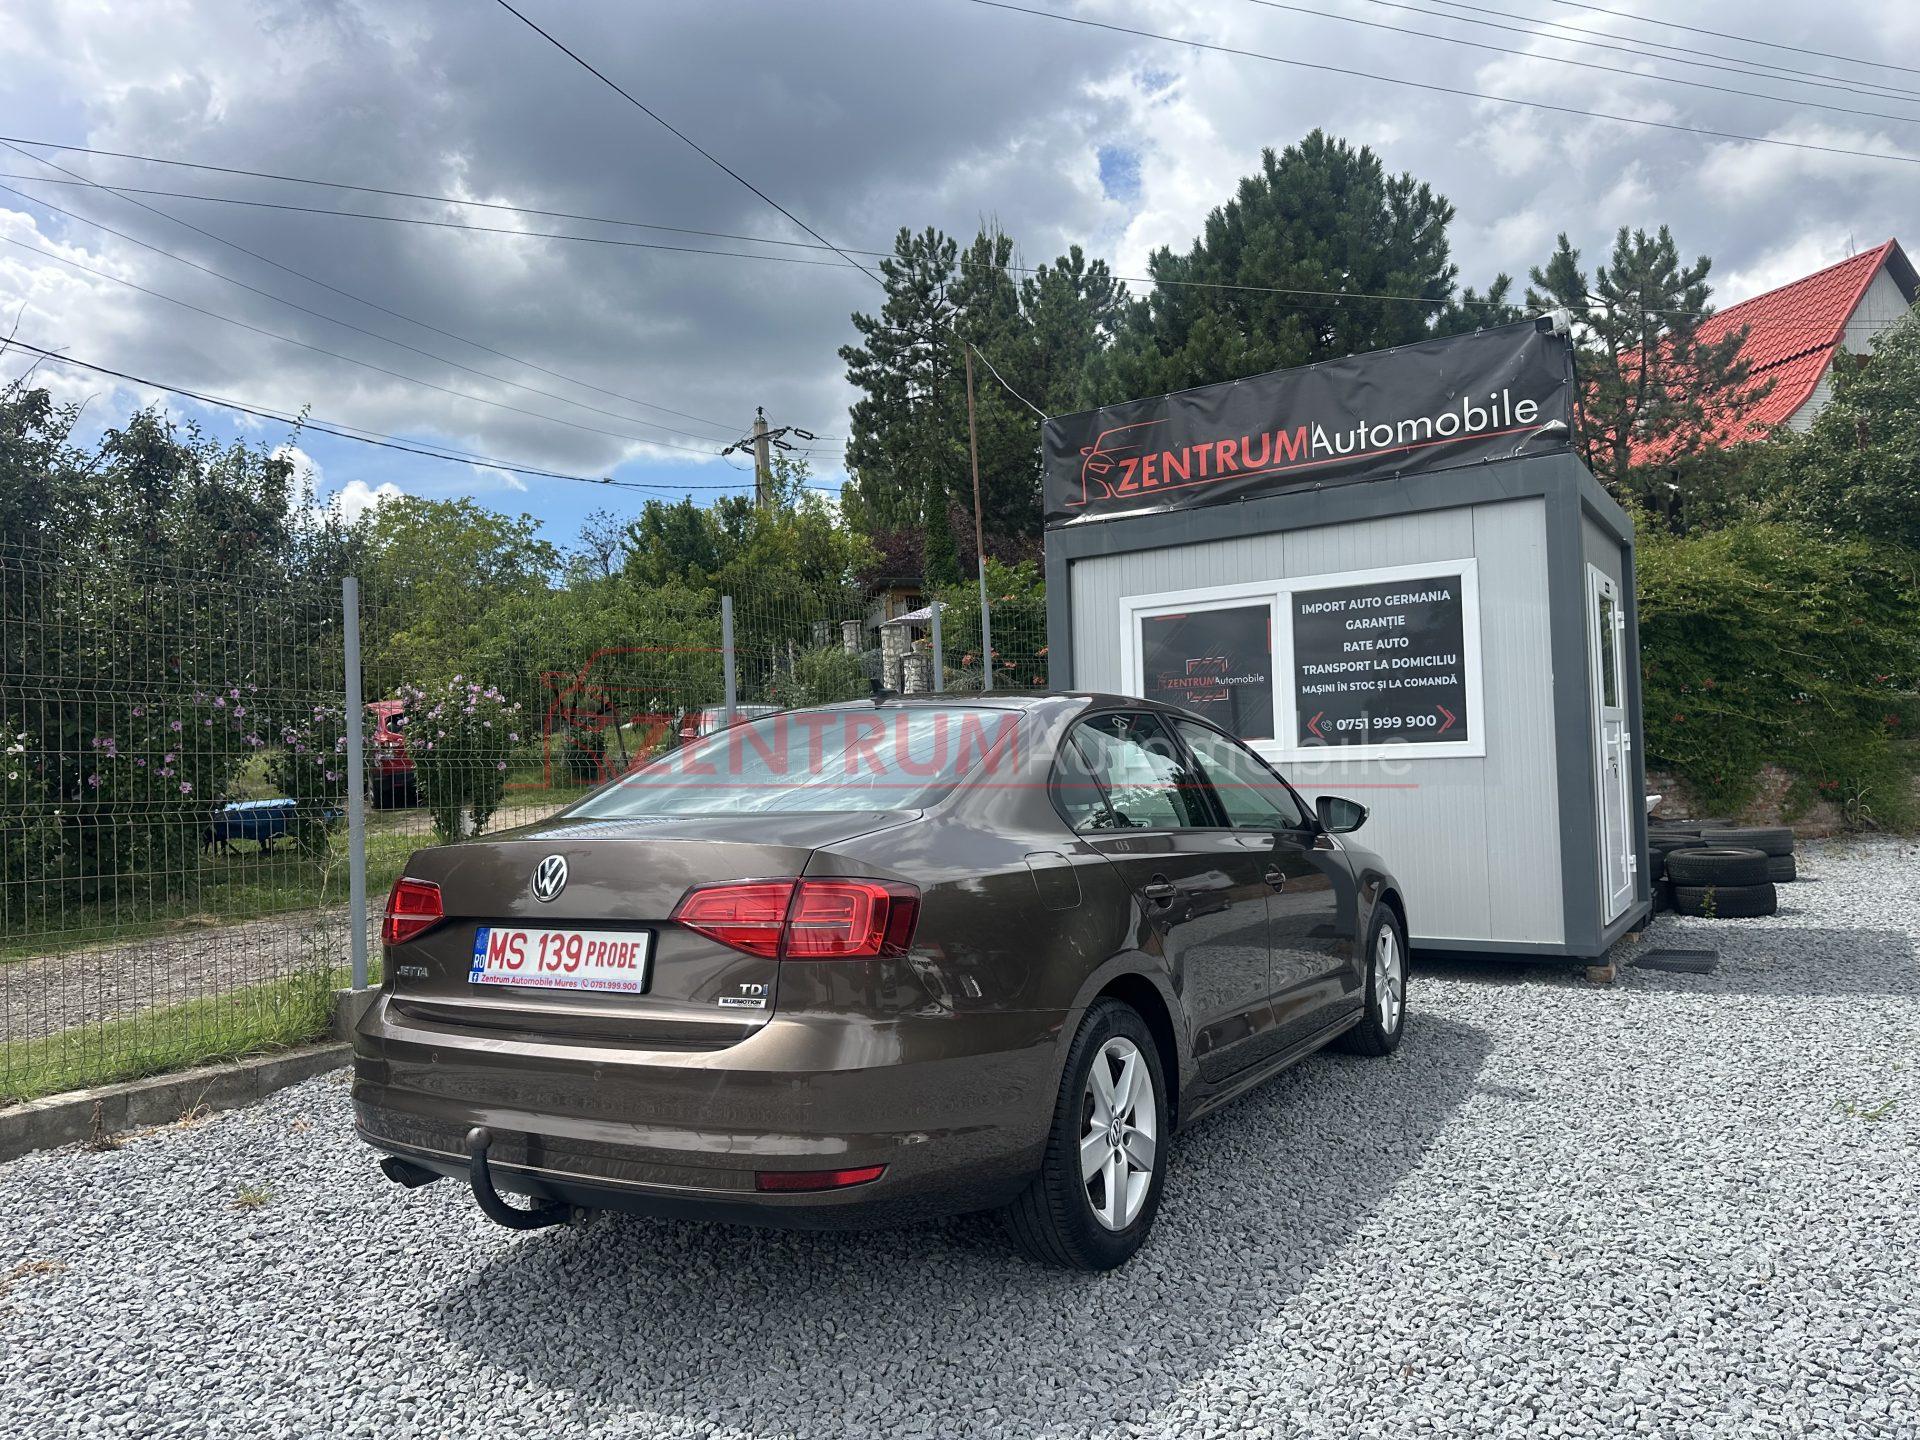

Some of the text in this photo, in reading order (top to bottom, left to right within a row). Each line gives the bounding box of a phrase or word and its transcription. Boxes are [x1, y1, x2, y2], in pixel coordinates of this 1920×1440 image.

[1117, 389, 1539, 492] ZENTRUM Automobile
[1302, 590, 1451, 615] IMPORT AUTO GERMANIA
[1345, 615, 1406, 630] GARANȚIE
[1343, 637, 1410, 652] RATE AUTO
[1302, 654, 1456, 675] TRANSPORT LA DOMICILIU
[1167, 673, 1265, 688] ZENTRUM Automobile
[1302, 673, 1458, 695] MAȘINI ÎN STOC ȘI LA COMANDĂ
[1336, 714, 1437, 731] 0751 999 900
[487, 932, 640, 972] MS 139 PROBE
[473, 954, 486, 968] RO
[481, 974, 638, 991] Zentrum Automobile Mures 0751.999.900
